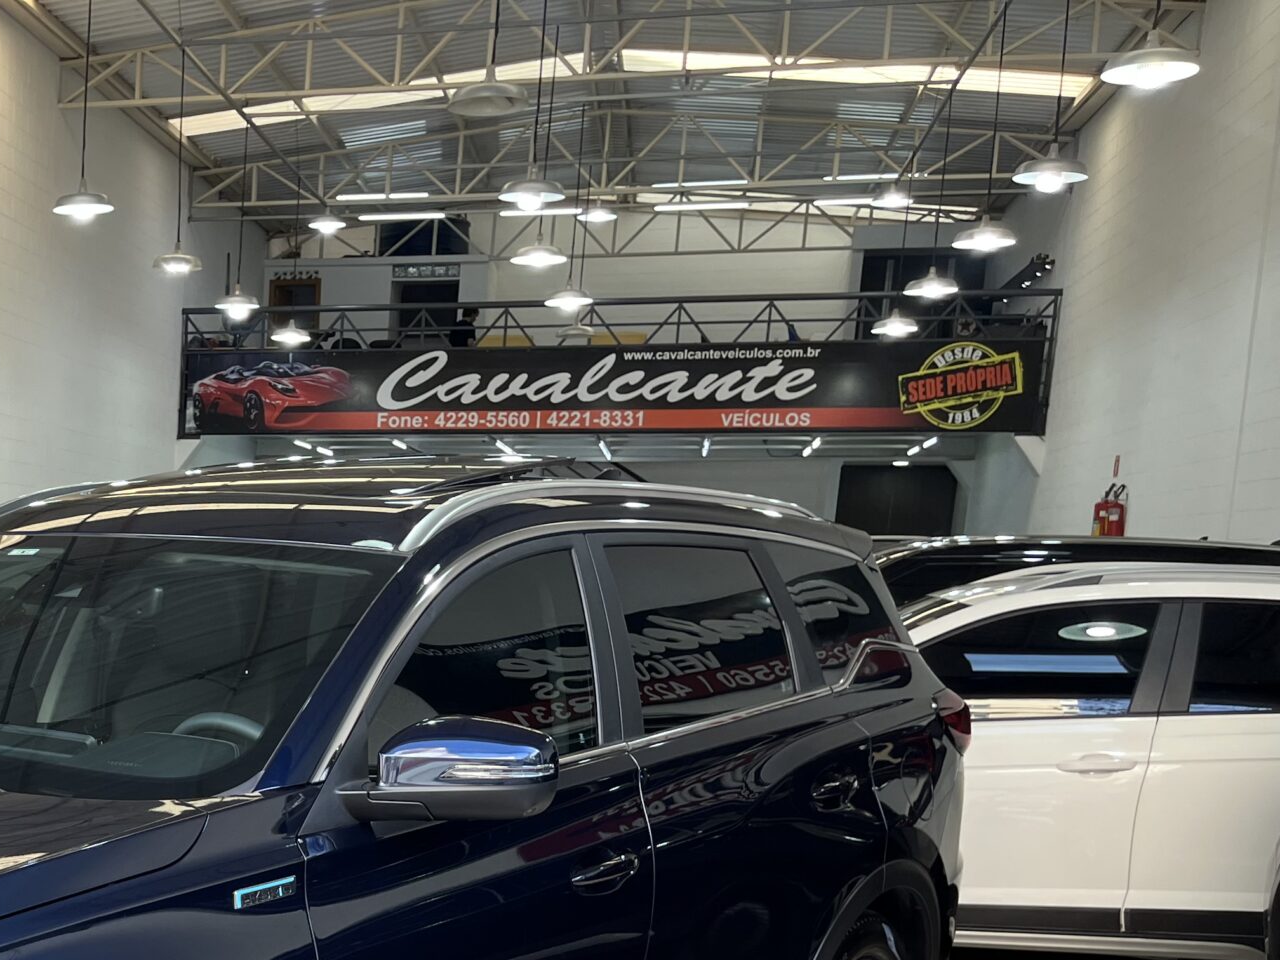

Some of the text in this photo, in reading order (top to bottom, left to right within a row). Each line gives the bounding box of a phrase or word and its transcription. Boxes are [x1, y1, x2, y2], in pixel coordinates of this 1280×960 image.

[623, 348, 821, 362] www.cavalcanteveiculos.com.br
[933, 346, 983, 369] Desde
[376, 350, 818, 411] Cavalcante
[907, 362, 1012, 403] SEDE PRÓPRIA
[377, 412, 428, 428] Fone:
[434, 412, 530, 428] 4229-5560
[546, 410, 645, 428] 4221-8331
[721, 410, 811, 428] VEÍCULOS
[947, 407, 980, 424] 1984
